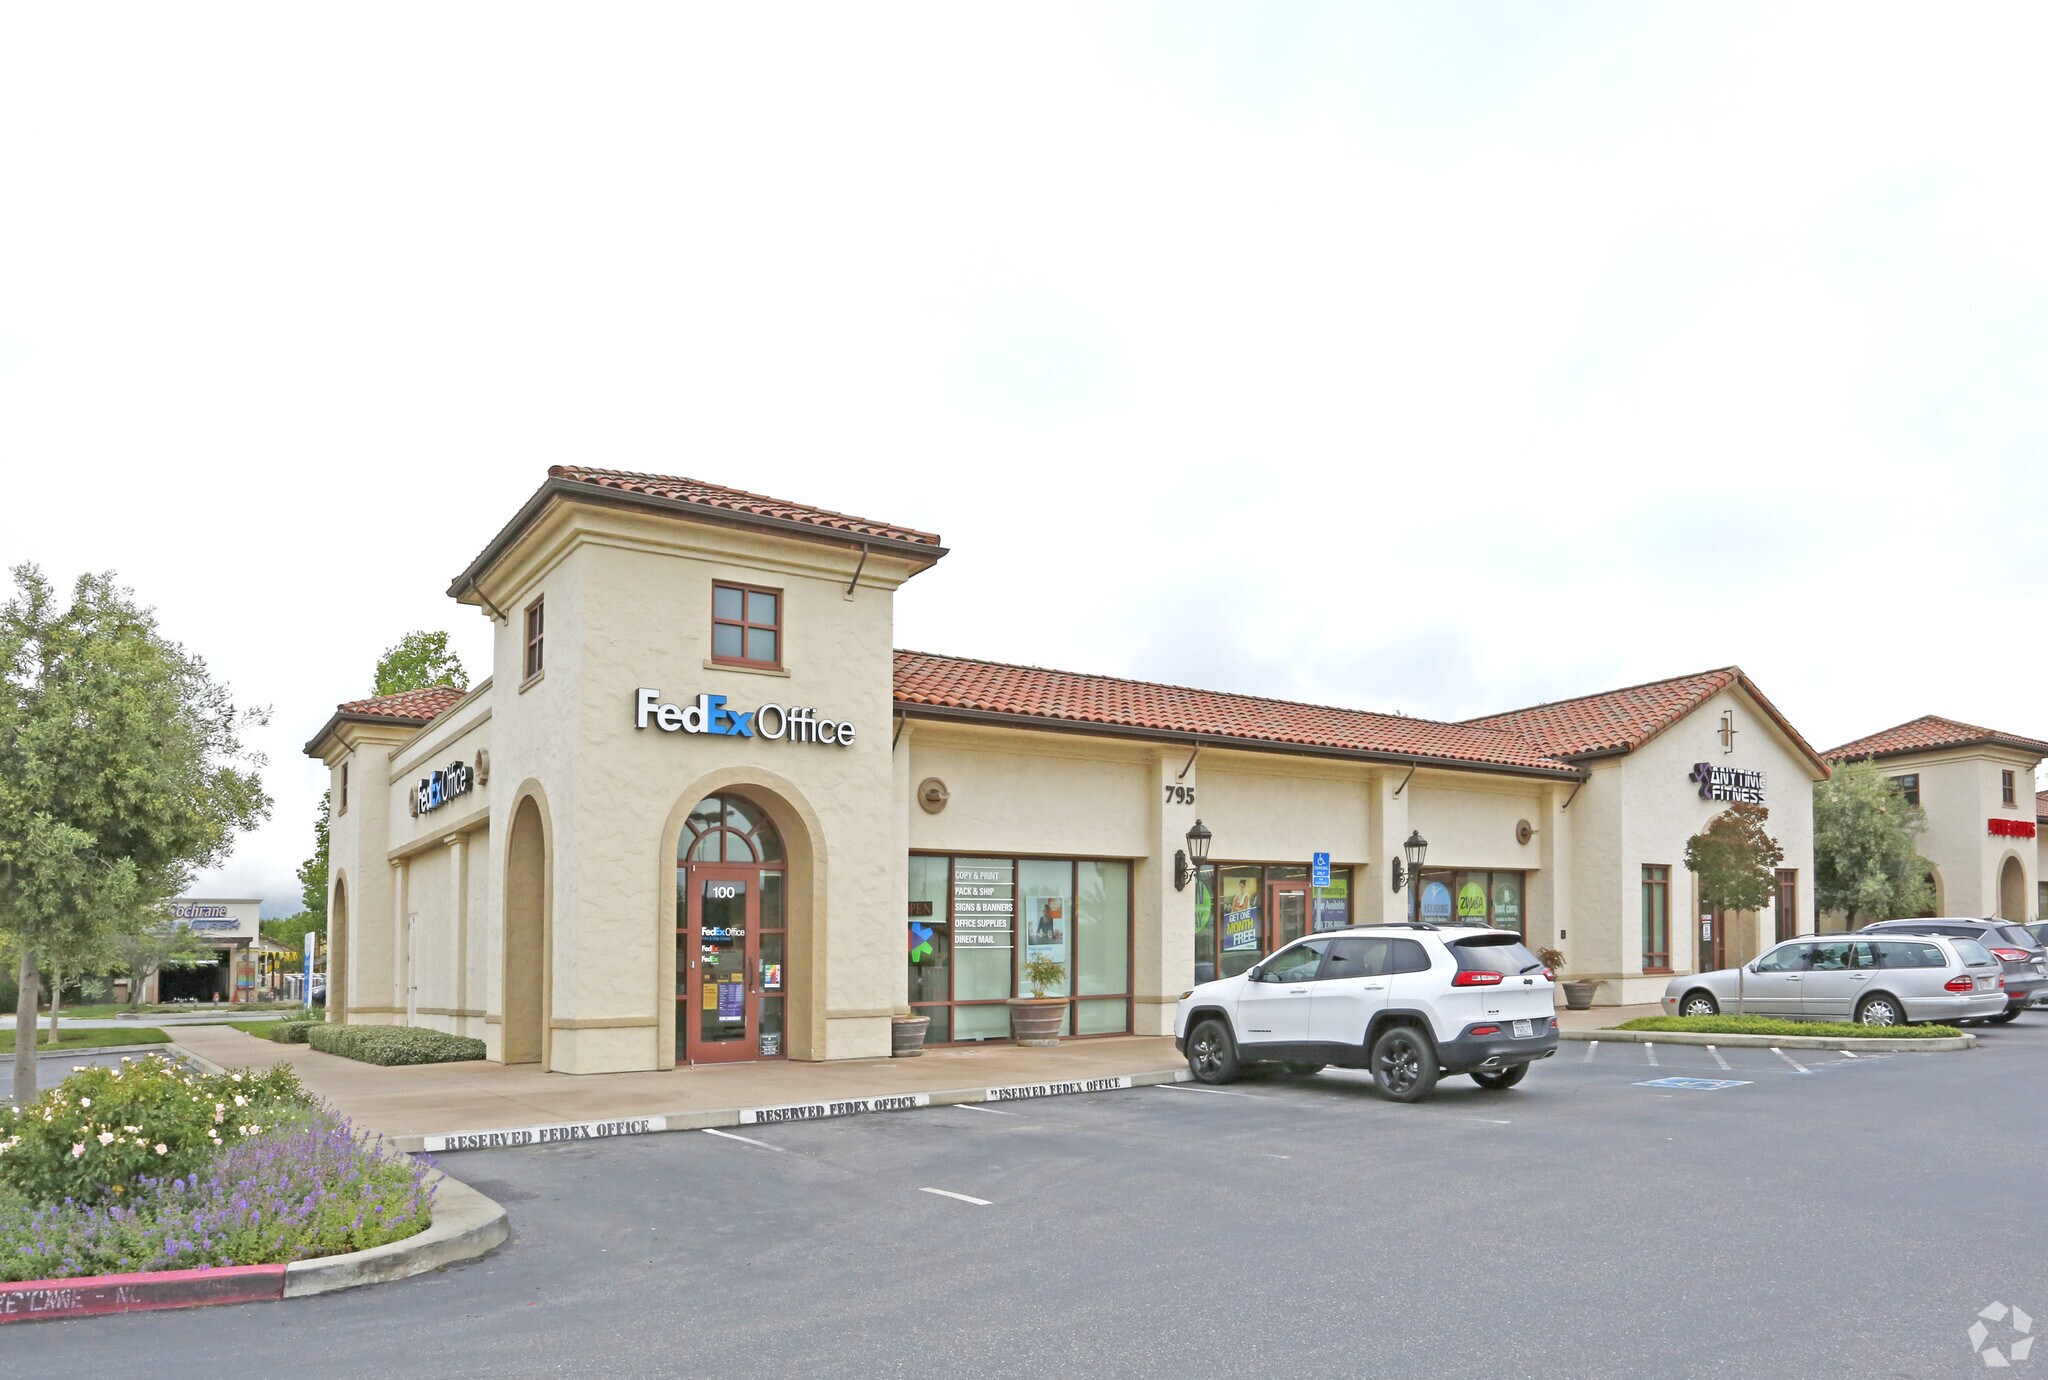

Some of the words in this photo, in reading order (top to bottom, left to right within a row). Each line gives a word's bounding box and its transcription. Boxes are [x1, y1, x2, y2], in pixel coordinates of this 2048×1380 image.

[635, 687, 754, 737] FedEx
[755, 703, 856, 746] Office
[1710, 766, 1766, 788] ANYTIME
[418, 771, 442, 815] FedEx
[1165, 785, 1195, 805] 795
[1712, 785, 1766, 804] FITNESS
[955, 871, 972, 879] COPY
[973, 872, 979, 880] &
[980, 872, 999, 880] PRINT
[713, 886, 735, 899] 100
[955, 887, 972, 896] PACK
[973, 888, 978, 896] &
[979, 888, 994, 896] SHIP
[169, 902, 227, 918] Cochrane
[909, 903, 932, 915] PEN
[955, 903, 975, 911] SIGNS
[976, 903, 982, 911] &
[982, 903, 1013, 912] BANNERS
[1460, 896, 1483, 910] ZUMBA
[955, 919, 976, 928] OFFICE
[977, 919, 1007, 928] SUPPLIES
[1230, 912, 1240, 923] GET
[1240, 910, 1251, 919] ONE
[702, 926, 725, 936] FedEx
[725, 927, 746, 936] Office
[1227, 918, 1254, 935] MONTH
[955, 935, 977, 944] DIRECT
[978, 936, 995, 944] MAIL
[1233, 928, 1256, 946] FREE!
[1050, 1082, 1083, 1095] FEDEX
[1086, 1077, 1121, 1092] OFFICE
[756, 1105, 825, 1123] RESERVED
[829, 1100, 870, 1116] FEDEX
[874, 1096, 916, 1111] OFFICE
[445, 1130, 532, 1150] RESERVED
[539, 1125, 591, 1143] FEDEX
[596, 1119, 650, 1136] OFFICE
